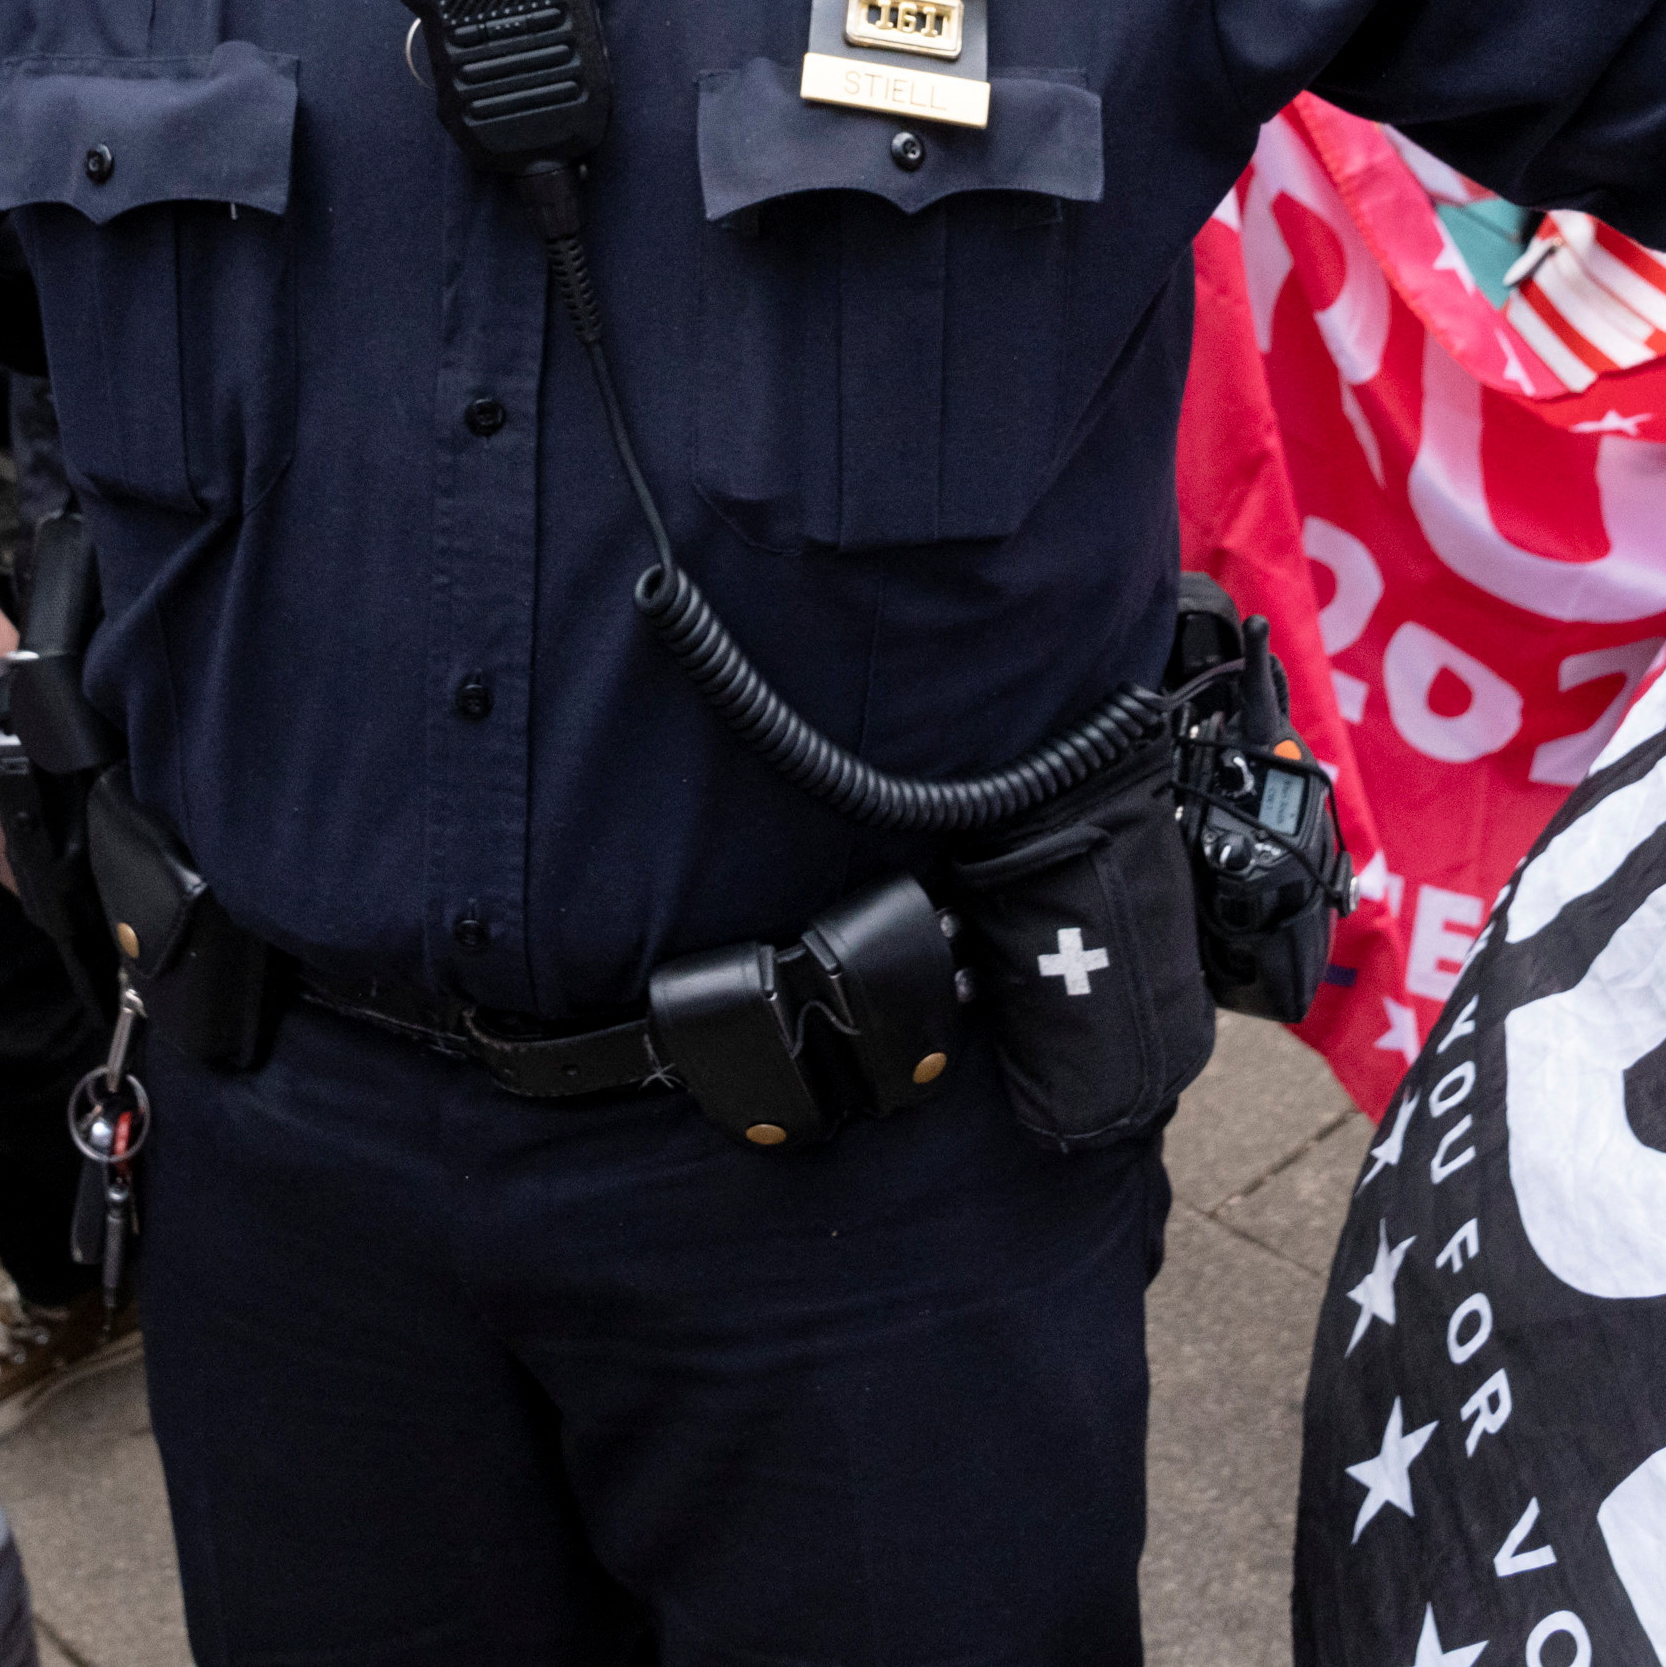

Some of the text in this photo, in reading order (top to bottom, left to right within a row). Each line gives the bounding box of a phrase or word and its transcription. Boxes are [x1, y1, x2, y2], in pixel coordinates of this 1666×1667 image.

[844, 70, 948, 111] STIELL
[1428, 994, 1480, 1184] YOU
[1435, 1218, 1513, 1458] FOR
